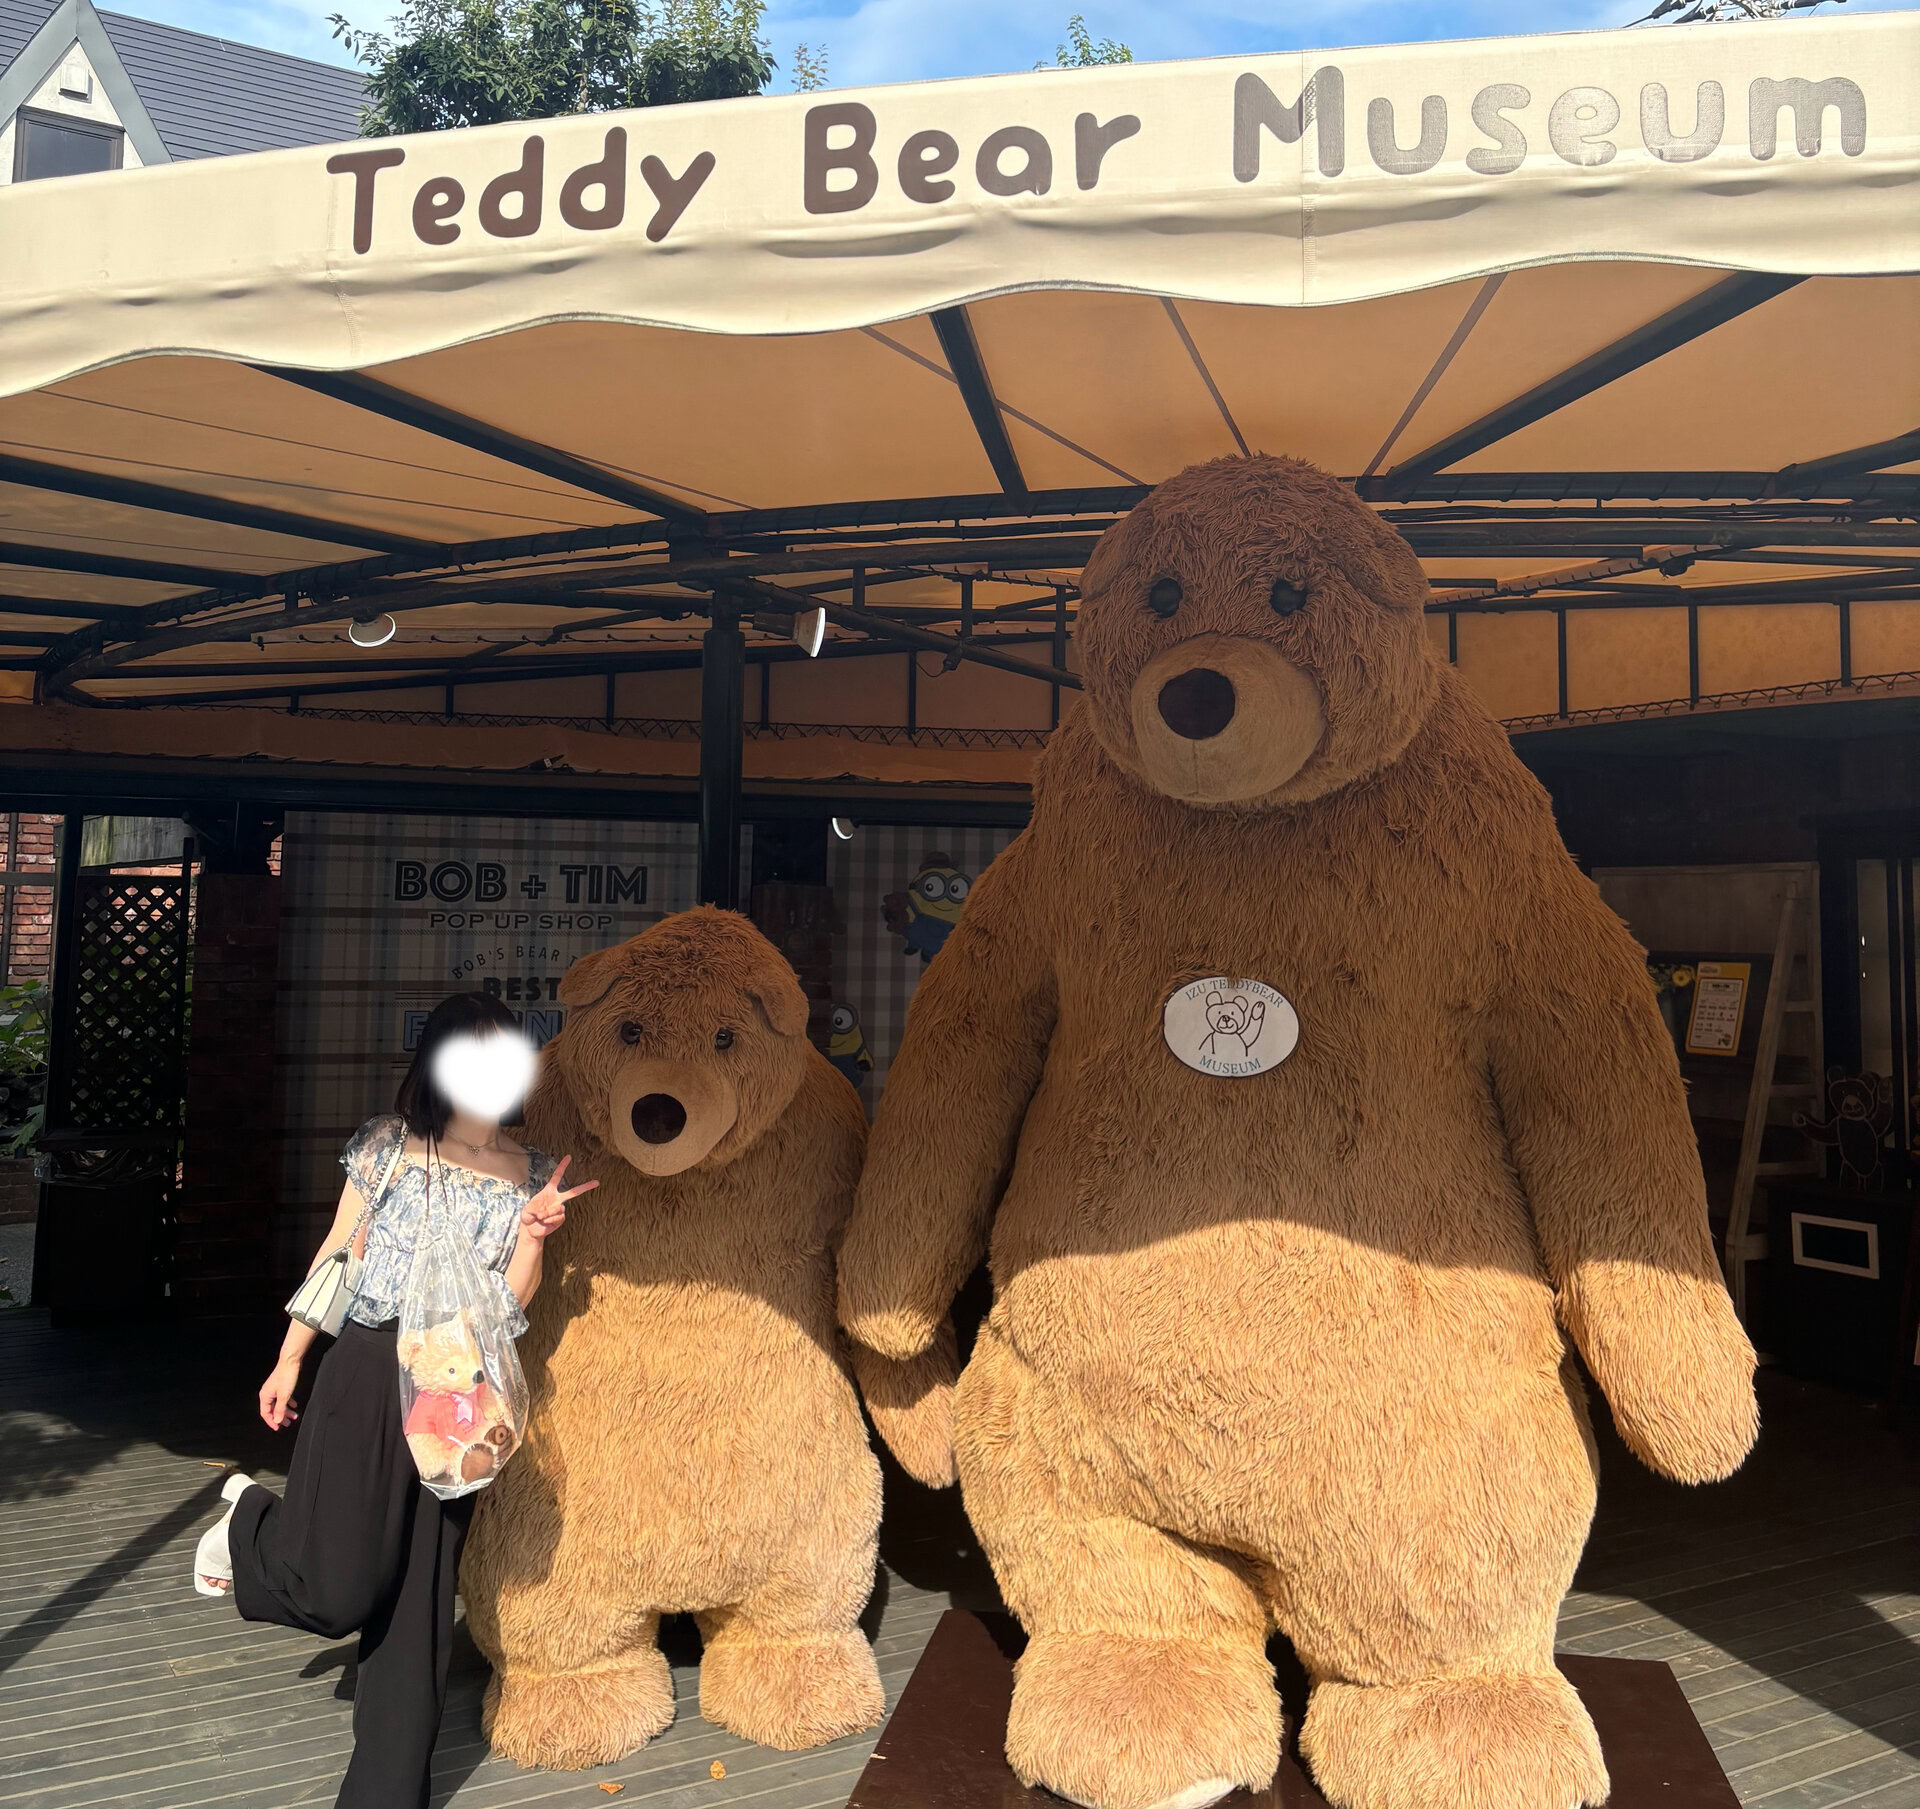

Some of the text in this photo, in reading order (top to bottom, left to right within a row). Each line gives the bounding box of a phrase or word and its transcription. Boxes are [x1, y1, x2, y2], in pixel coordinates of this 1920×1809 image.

[326, 65, 1867, 256] Teddy Bear Museum
[394, 860, 649, 905] BOB + TIM
[430, 913, 612, 931] POP UP SHOP
[451, 947, 506, 980] BOB'S
[516, 945, 560, 962] BEAR
[482, 976, 562, 1002] BEST
[1185, 984, 1207, 1001] IZU
[1199, 1055, 1262, 1075] MUSEUM
